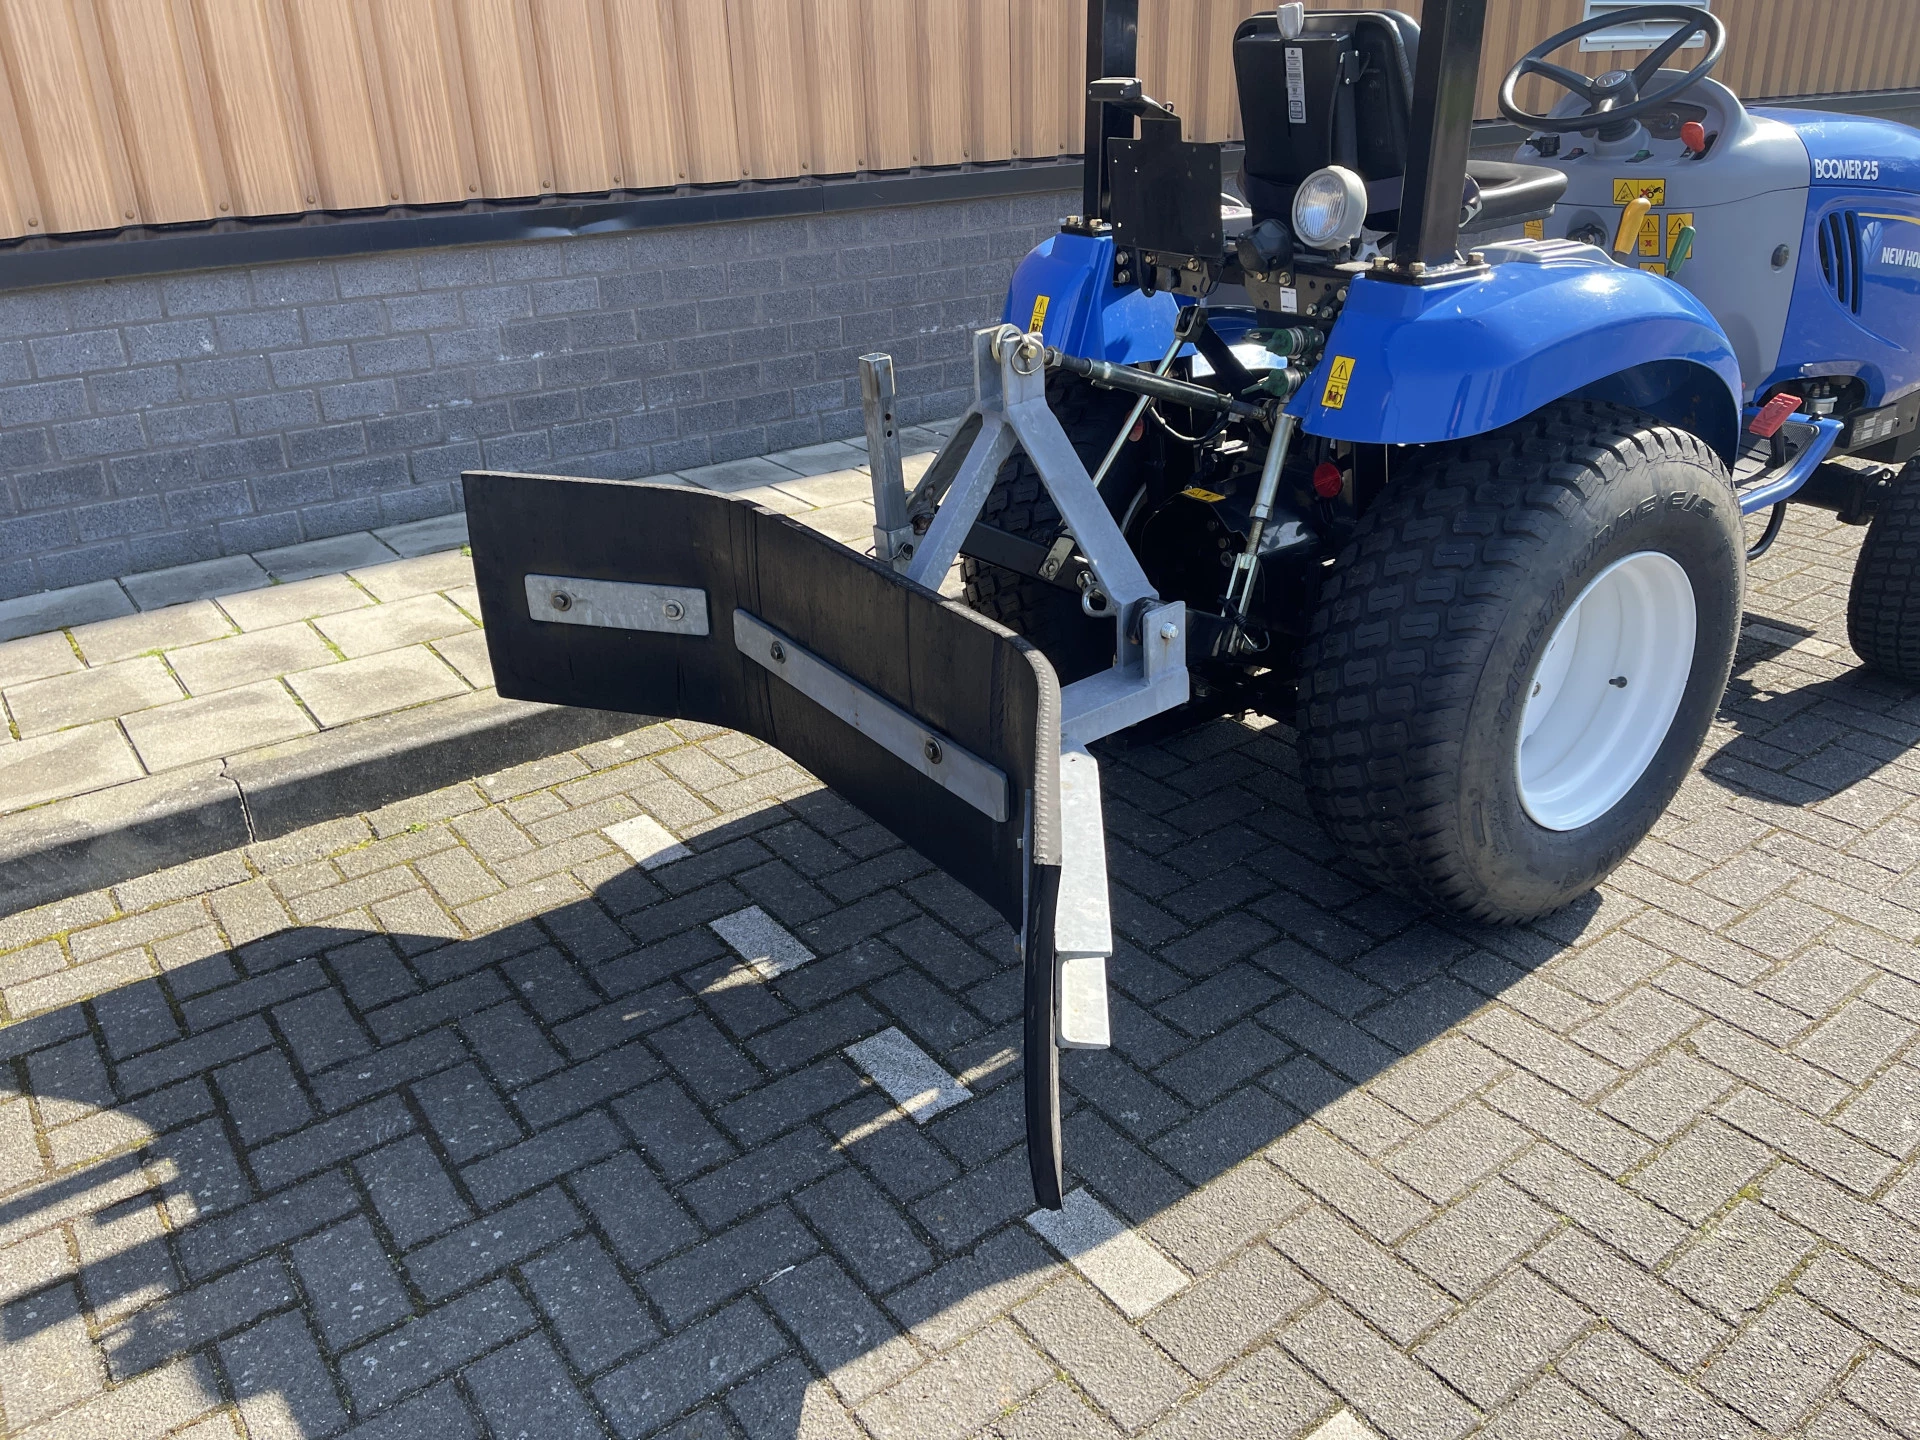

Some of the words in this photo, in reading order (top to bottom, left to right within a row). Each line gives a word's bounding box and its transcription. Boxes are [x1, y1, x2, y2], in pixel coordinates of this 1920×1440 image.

[1814, 159, 1861, 179] BOOMER
[1863, 161, 1879, 180] 25
[1881, 247, 1905, 265] NEW
